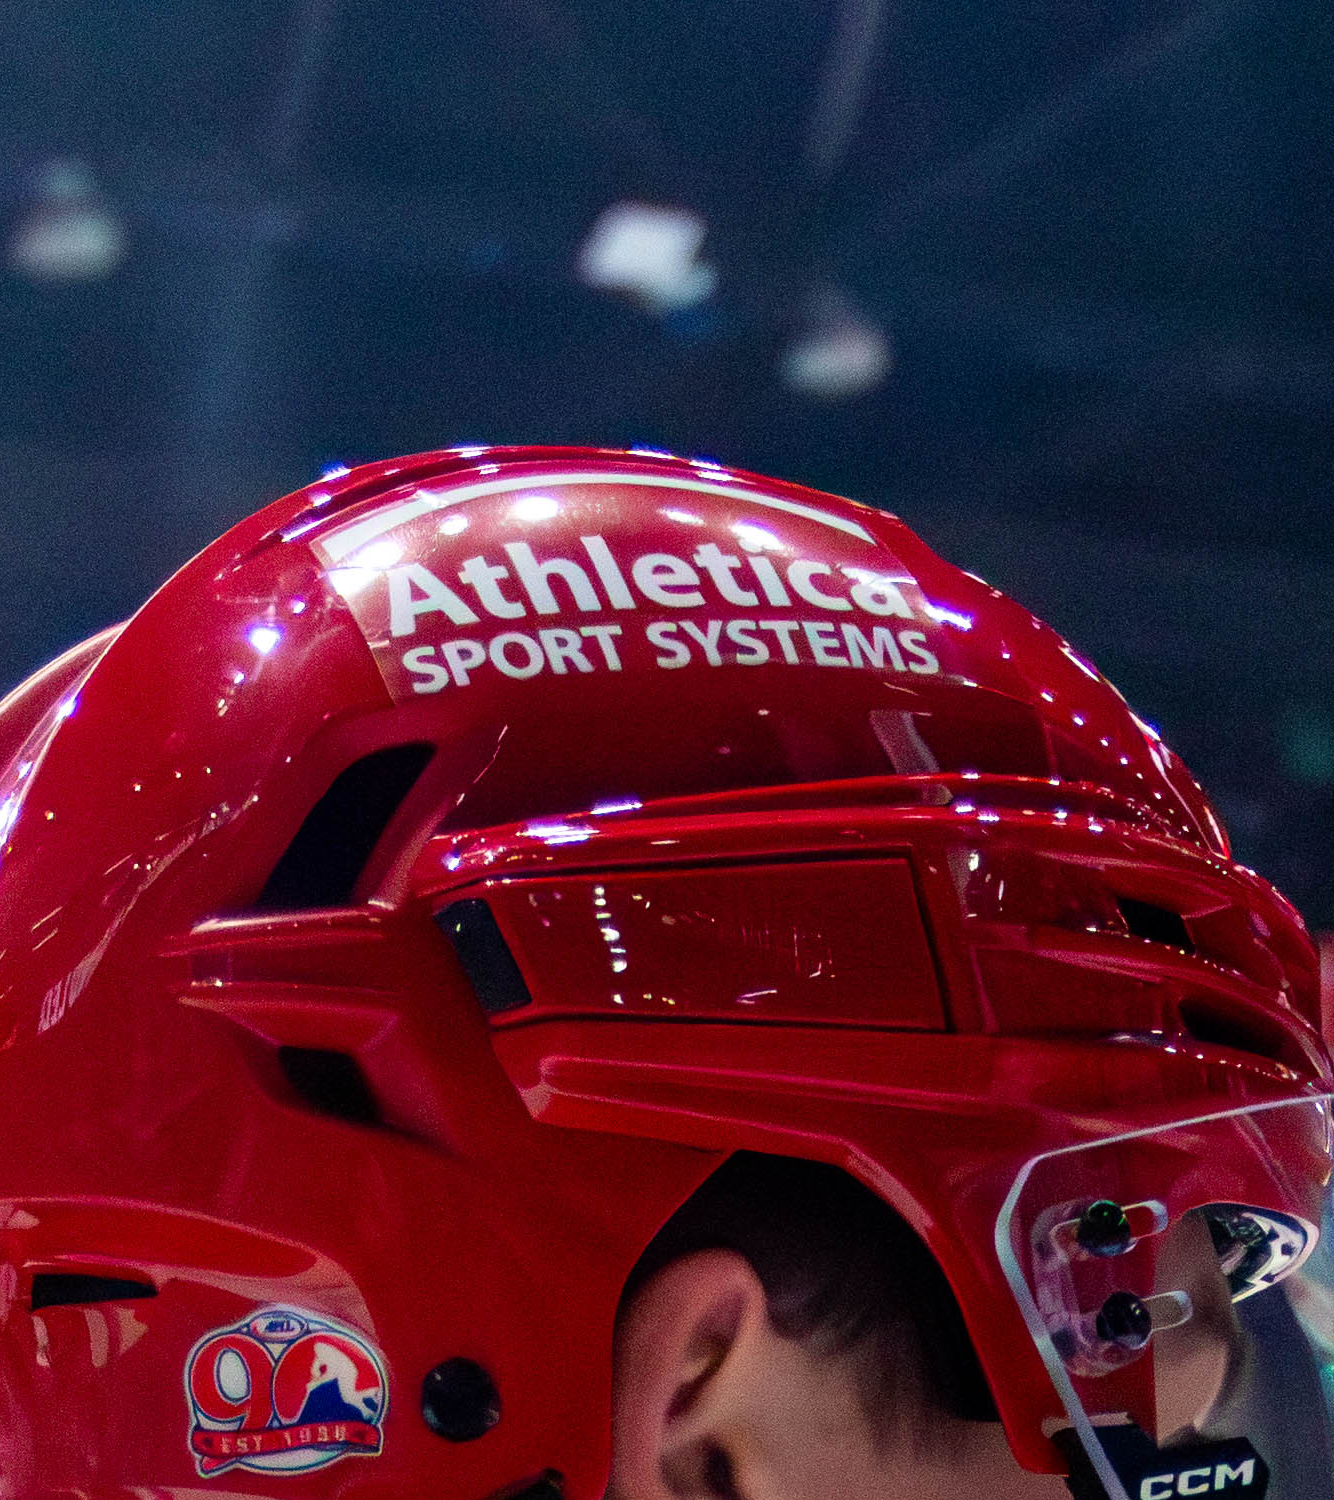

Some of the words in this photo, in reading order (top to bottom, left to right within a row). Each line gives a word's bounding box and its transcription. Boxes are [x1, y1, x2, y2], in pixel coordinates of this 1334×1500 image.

[384, 528, 916, 637] Athletica
[401, 623, 623, 695] SPORT
[646, 617, 941, 676] SYSTEMS
